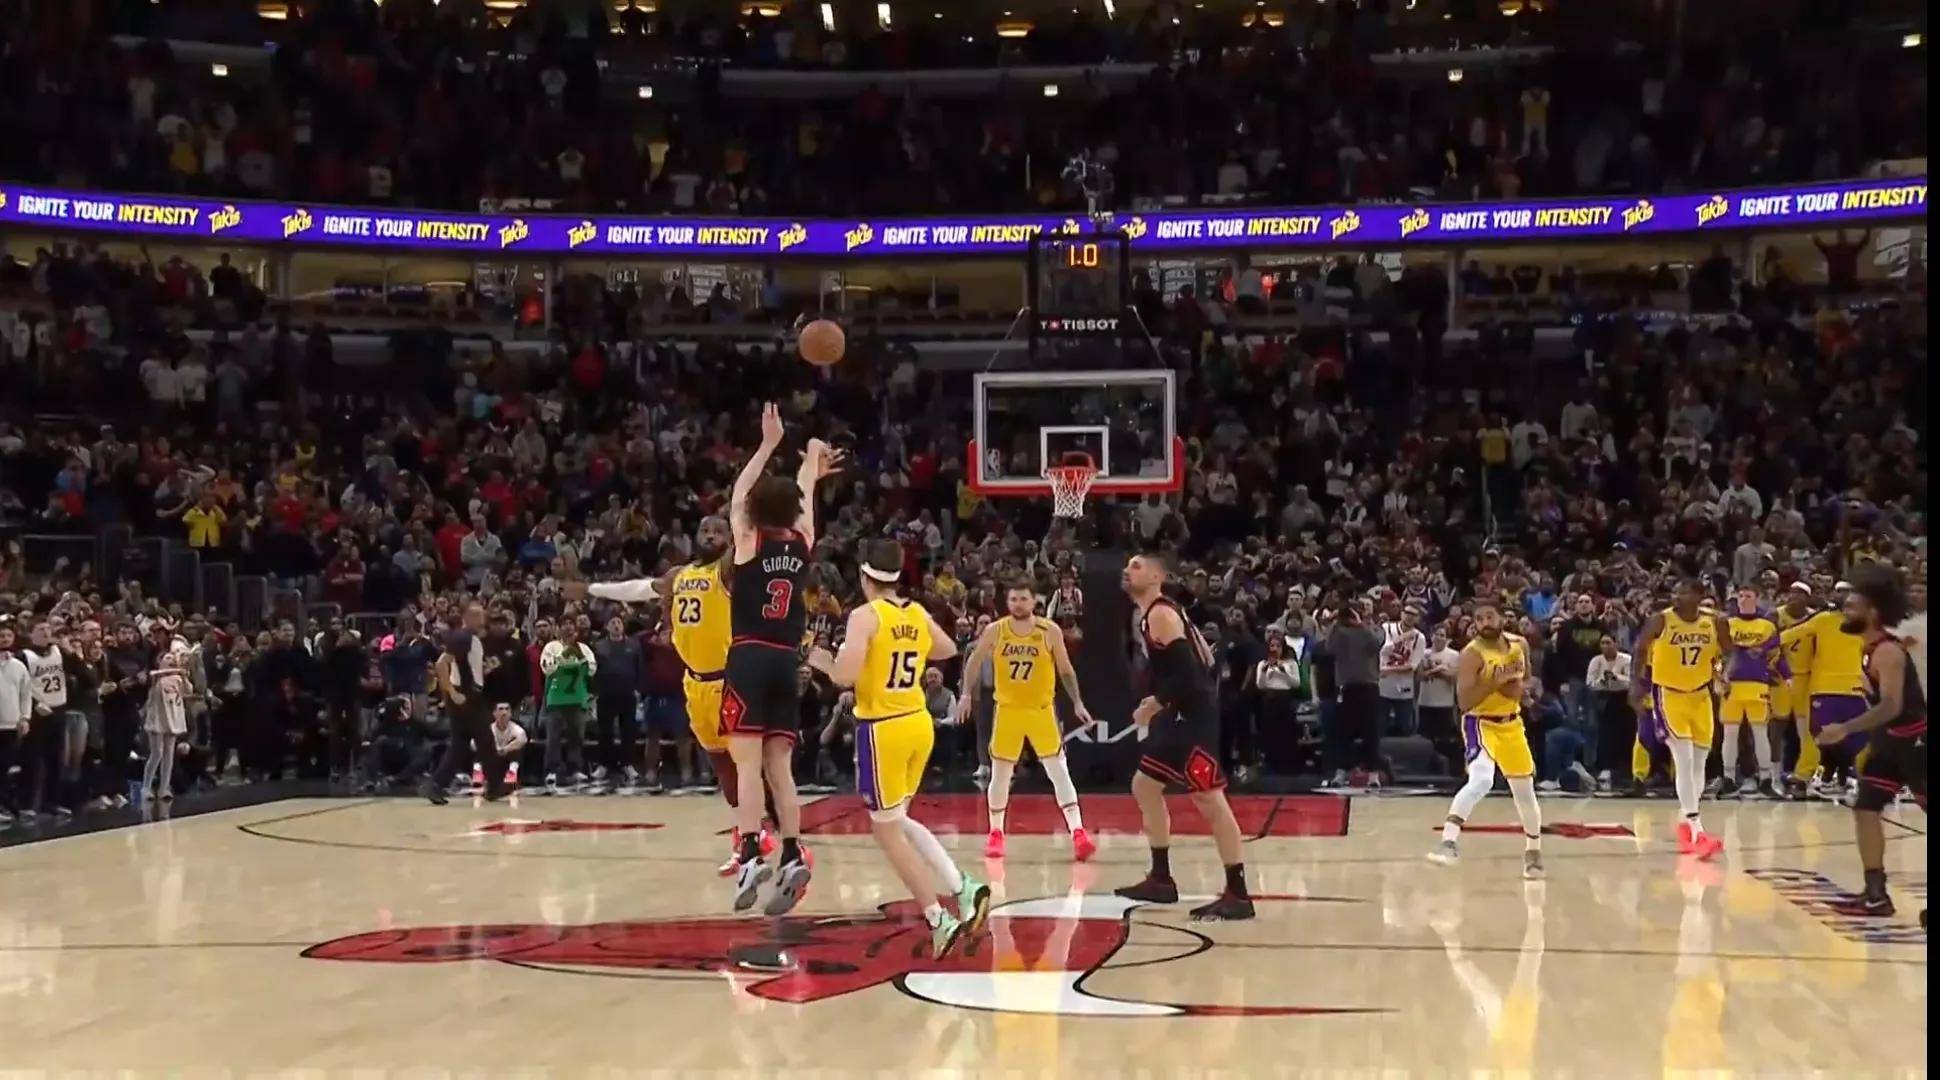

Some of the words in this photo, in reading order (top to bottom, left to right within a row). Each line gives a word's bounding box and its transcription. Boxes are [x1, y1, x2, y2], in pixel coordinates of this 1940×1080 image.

[18, 195, 69, 217] IGNITE
[73, 200, 114, 220] YOUR
[117, 204, 199, 226] INTENSITY
[1621, 199, 1654, 231] Takis
[1695, 195, 1728, 227] Takis
[1739, 195, 1792, 217] IGNITE
[1796, 192, 1839, 213] YOUR
[1842, 186, 1927, 210] INTENSITY
[208, 205, 241, 234] Takis
[280, 209, 313, 238] Takis
[323, 216, 371, 236] IGNITE
[375, 218, 413, 238] YOUR
[416, 220, 490, 241] INTENSITY
[1157, 220, 1203, 238] IGNITE
[1207, 219, 1245, 237] YOUR
[1247, 216, 1321, 236] INTENSITY
[1330, 210, 1360, 240] Takis
[1398, 208, 1430, 239] Takis
[1440, 211, 1488, 230] IGNITE
[1493, 210, 1532, 229] YOUR
[1535, 207, 1613, 227] INTENSITY
[498, 219, 529, 249] Takis
[567, 220, 598, 249] Takis
[607, 226, 653, 244] IGNITE
[657, 227, 694, 245] YOUR
[697, 227, 769, 246] INTENSITY
[777, 223, 807, 251] Takis
[844, 223, 873, 252] Takis
[883, 226, 928, 245] IGNITE
[932, 226, 968, 244] YOUR
[1070, 243, 1097, 267] 1.0
[1062, 318, 1118, 330] TISSOT
[762, 555, 804, 573] GIDDEY
[678, 597, 701, 623] 23
[762, 578, 793, 620] 3
[1670, 631, 1712, 645] LAKERS
[886, 651, 917, 689] 15
[1681, 646, 1702, 666] 17
[41, 676, 61, 693] 23
[1009, 661, 1033, 680] 77
